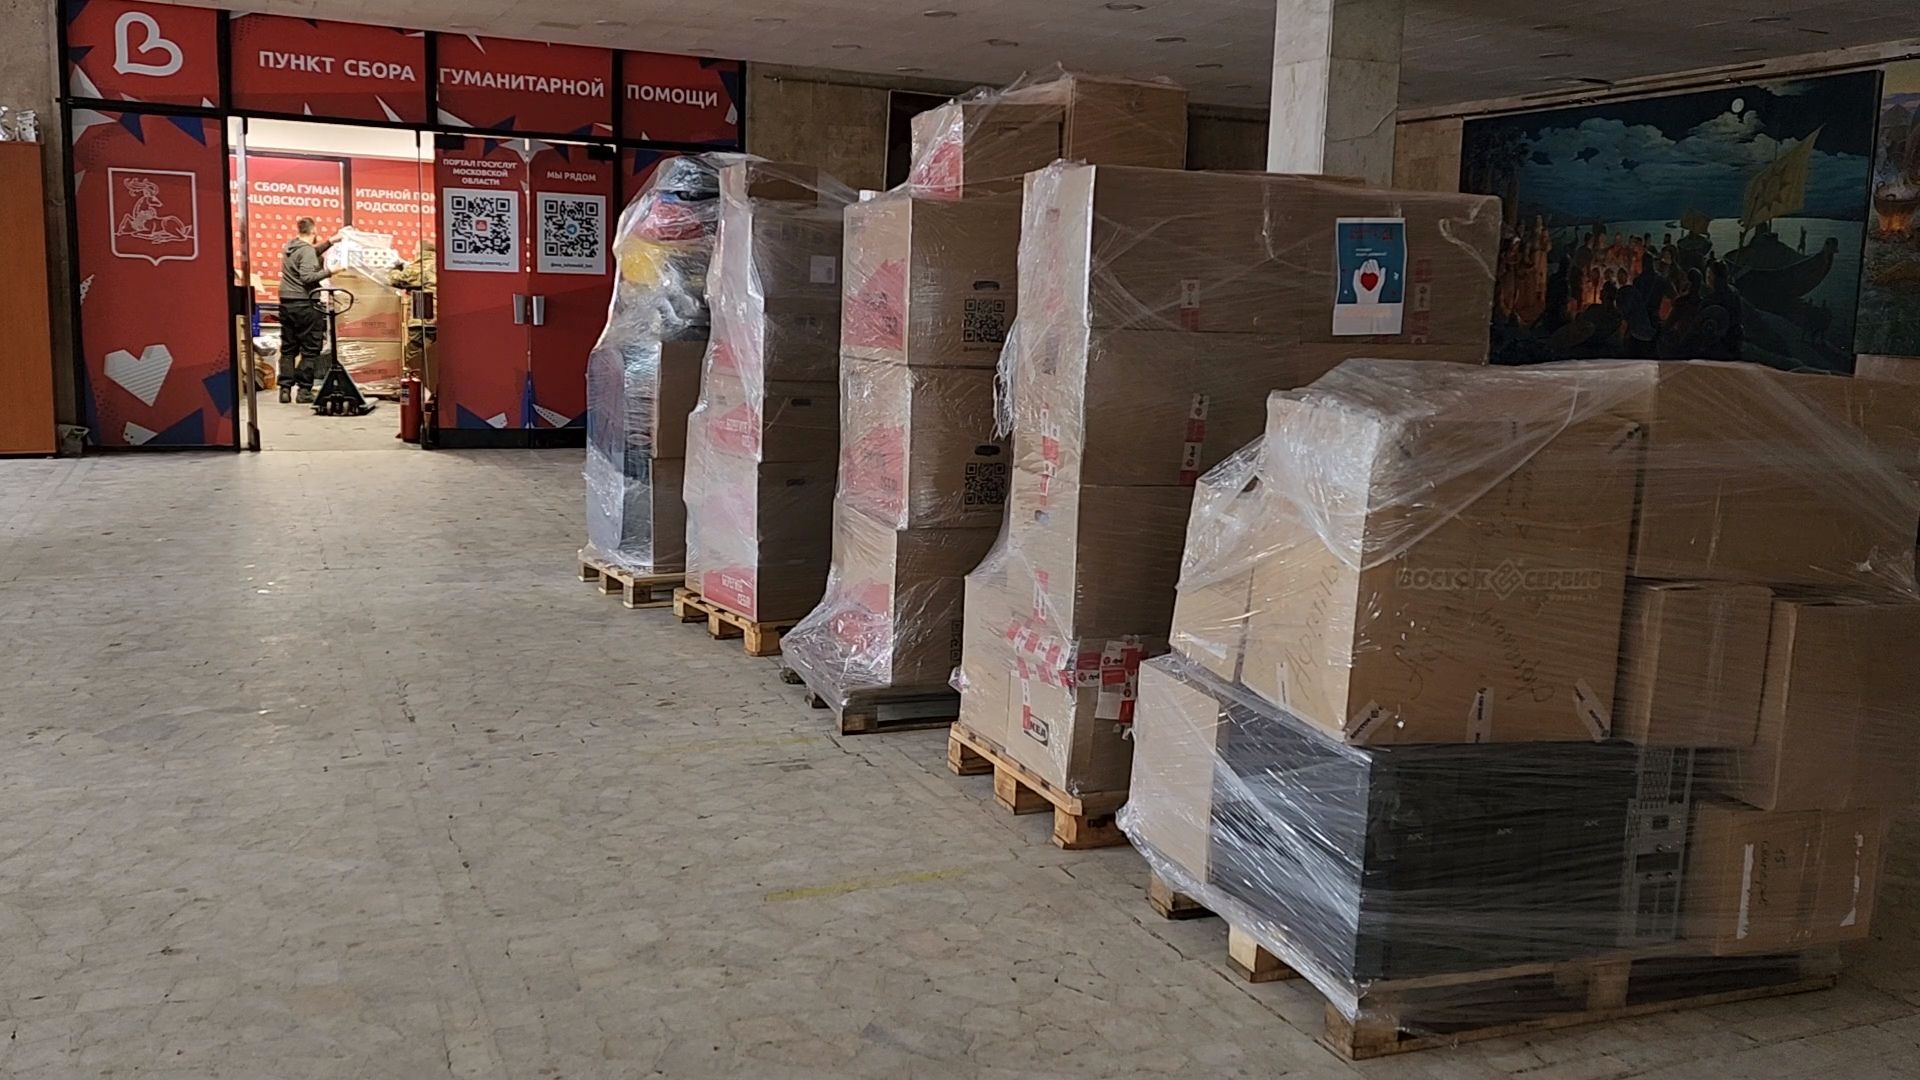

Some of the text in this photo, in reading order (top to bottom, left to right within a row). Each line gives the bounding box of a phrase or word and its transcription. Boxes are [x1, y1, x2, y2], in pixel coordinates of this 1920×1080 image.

[259, 51, 718, 108] ПУНКТ СБОРА ГУМАНИТАРНОЙ ПОМОЩИ
[443, 158, 518, 169] ПОРТАЛ ГОСУСЛУГ
[453, 168, 508, 177] МОСКОВСКОЙ
[546, 171, 597, 182] МЫ РЯДОМ
[461, 178, 500, 186] ОБЛАСТИ
[254, 181, 295, 195] СБОРА
